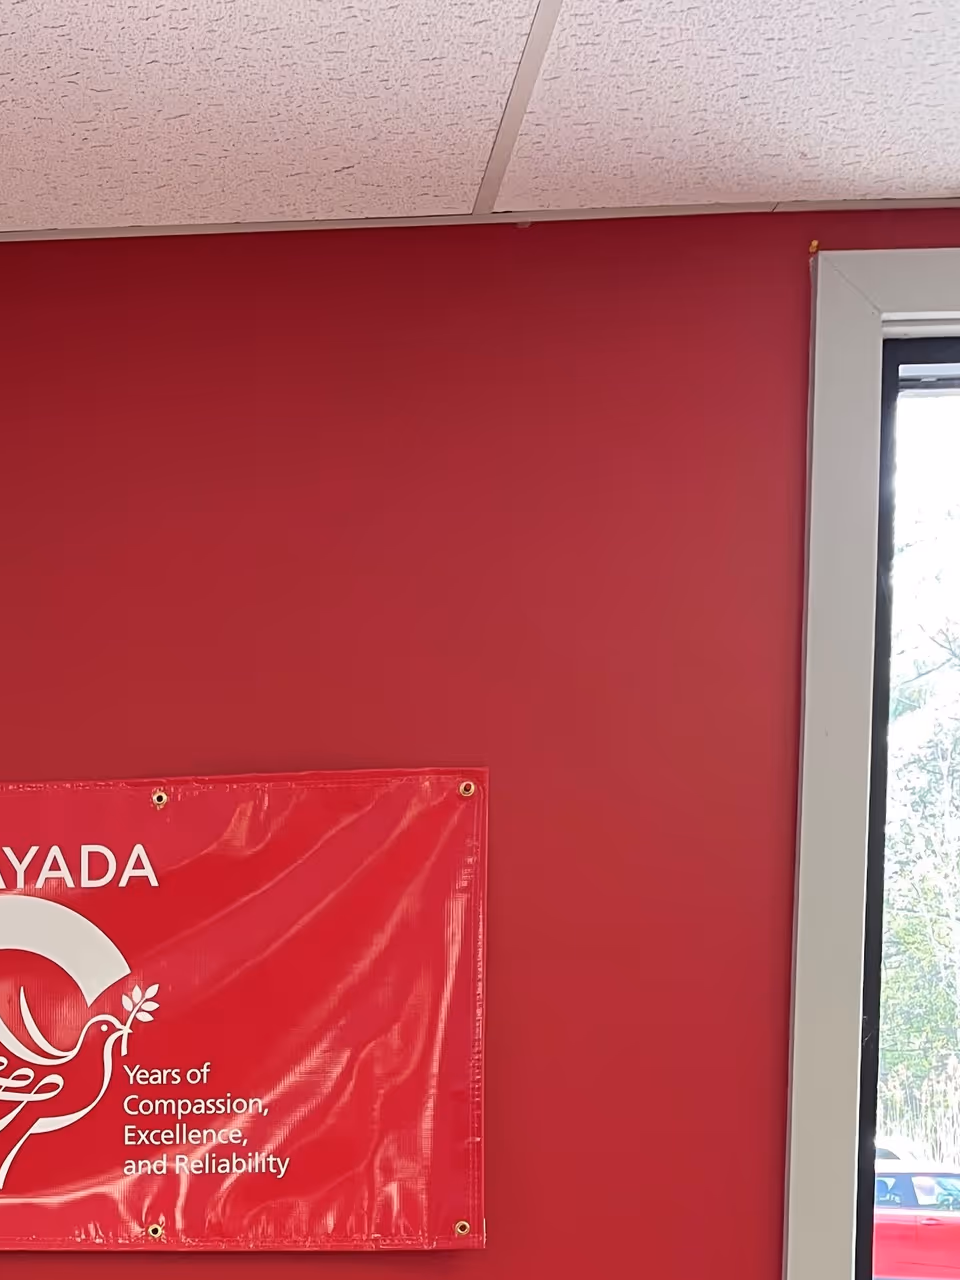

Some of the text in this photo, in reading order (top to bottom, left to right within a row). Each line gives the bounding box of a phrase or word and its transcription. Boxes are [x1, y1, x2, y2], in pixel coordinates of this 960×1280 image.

[122, 1062, 211, 1085] Years of
[123, 1093, 269, 1120] Compassion,
[123, 1123, 248, 1147] Excellence,
[123, 1152, 290, 1179] and Reliability
